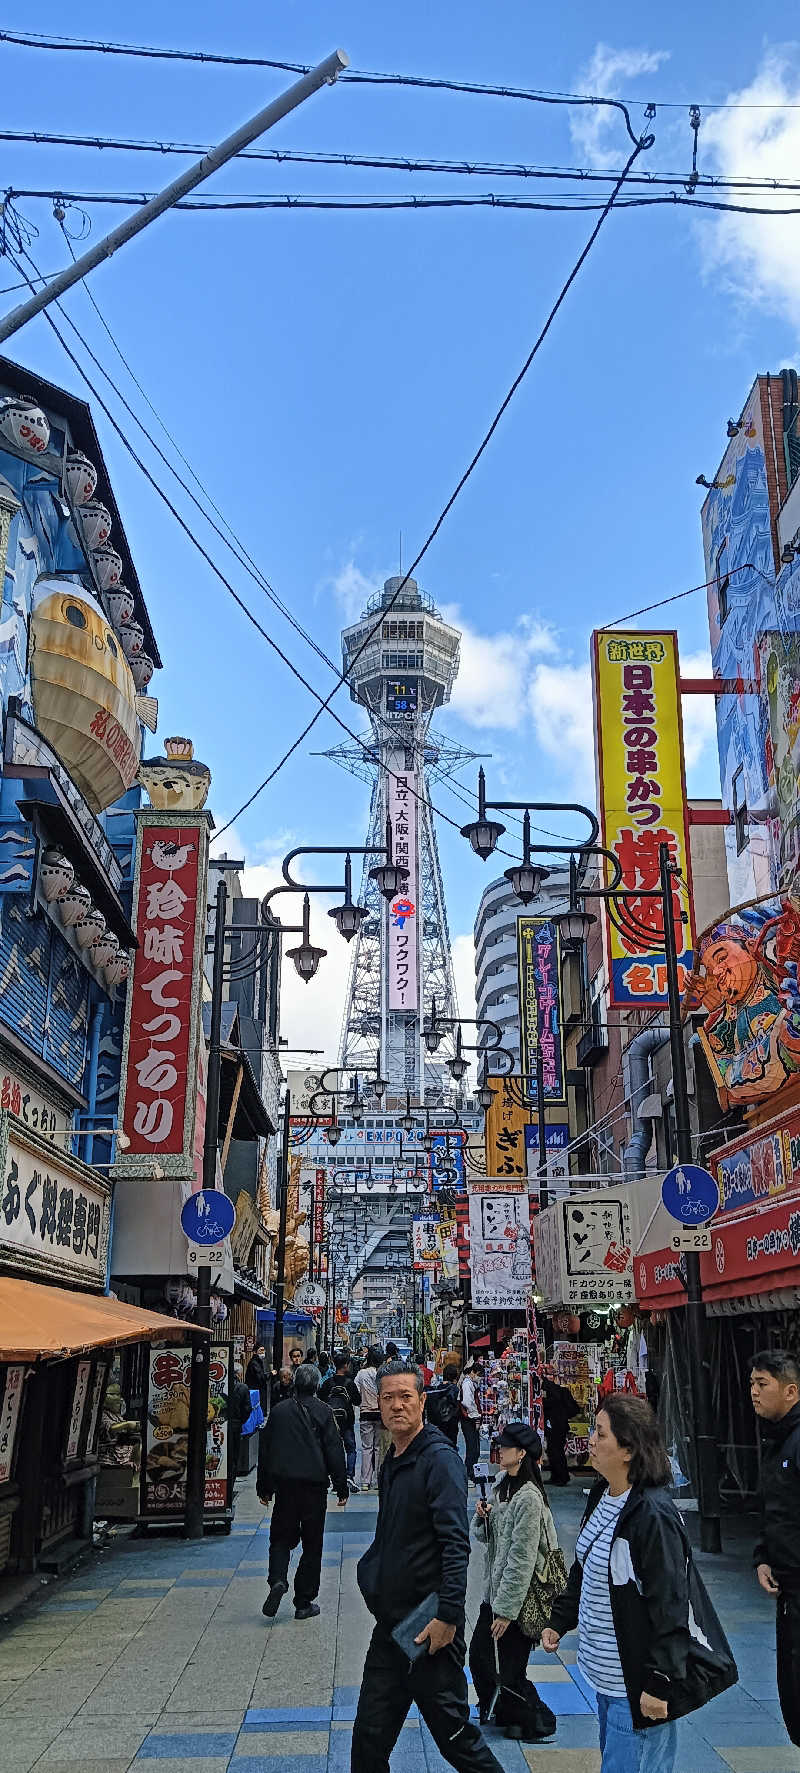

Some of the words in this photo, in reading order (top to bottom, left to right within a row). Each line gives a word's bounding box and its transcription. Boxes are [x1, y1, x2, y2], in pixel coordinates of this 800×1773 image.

[608, 640, 664, 661] 新世界
[395, 685, 406, 695] 11
[395, 700, 407, 710] 58
[623, 664, 661, 826] 日本一の串かつ
[133, 879, 189, 1144] 珍味てっちり
[366, 1131, 403, 1143] EXPO
[2, 1157, 100, 1259] ふぐ料理専門
[673, 1234, 709, 1248] 9-22
[189, 1252, 223, 1263] 9-22
[152, 1353, 227, 1391] 串つ
